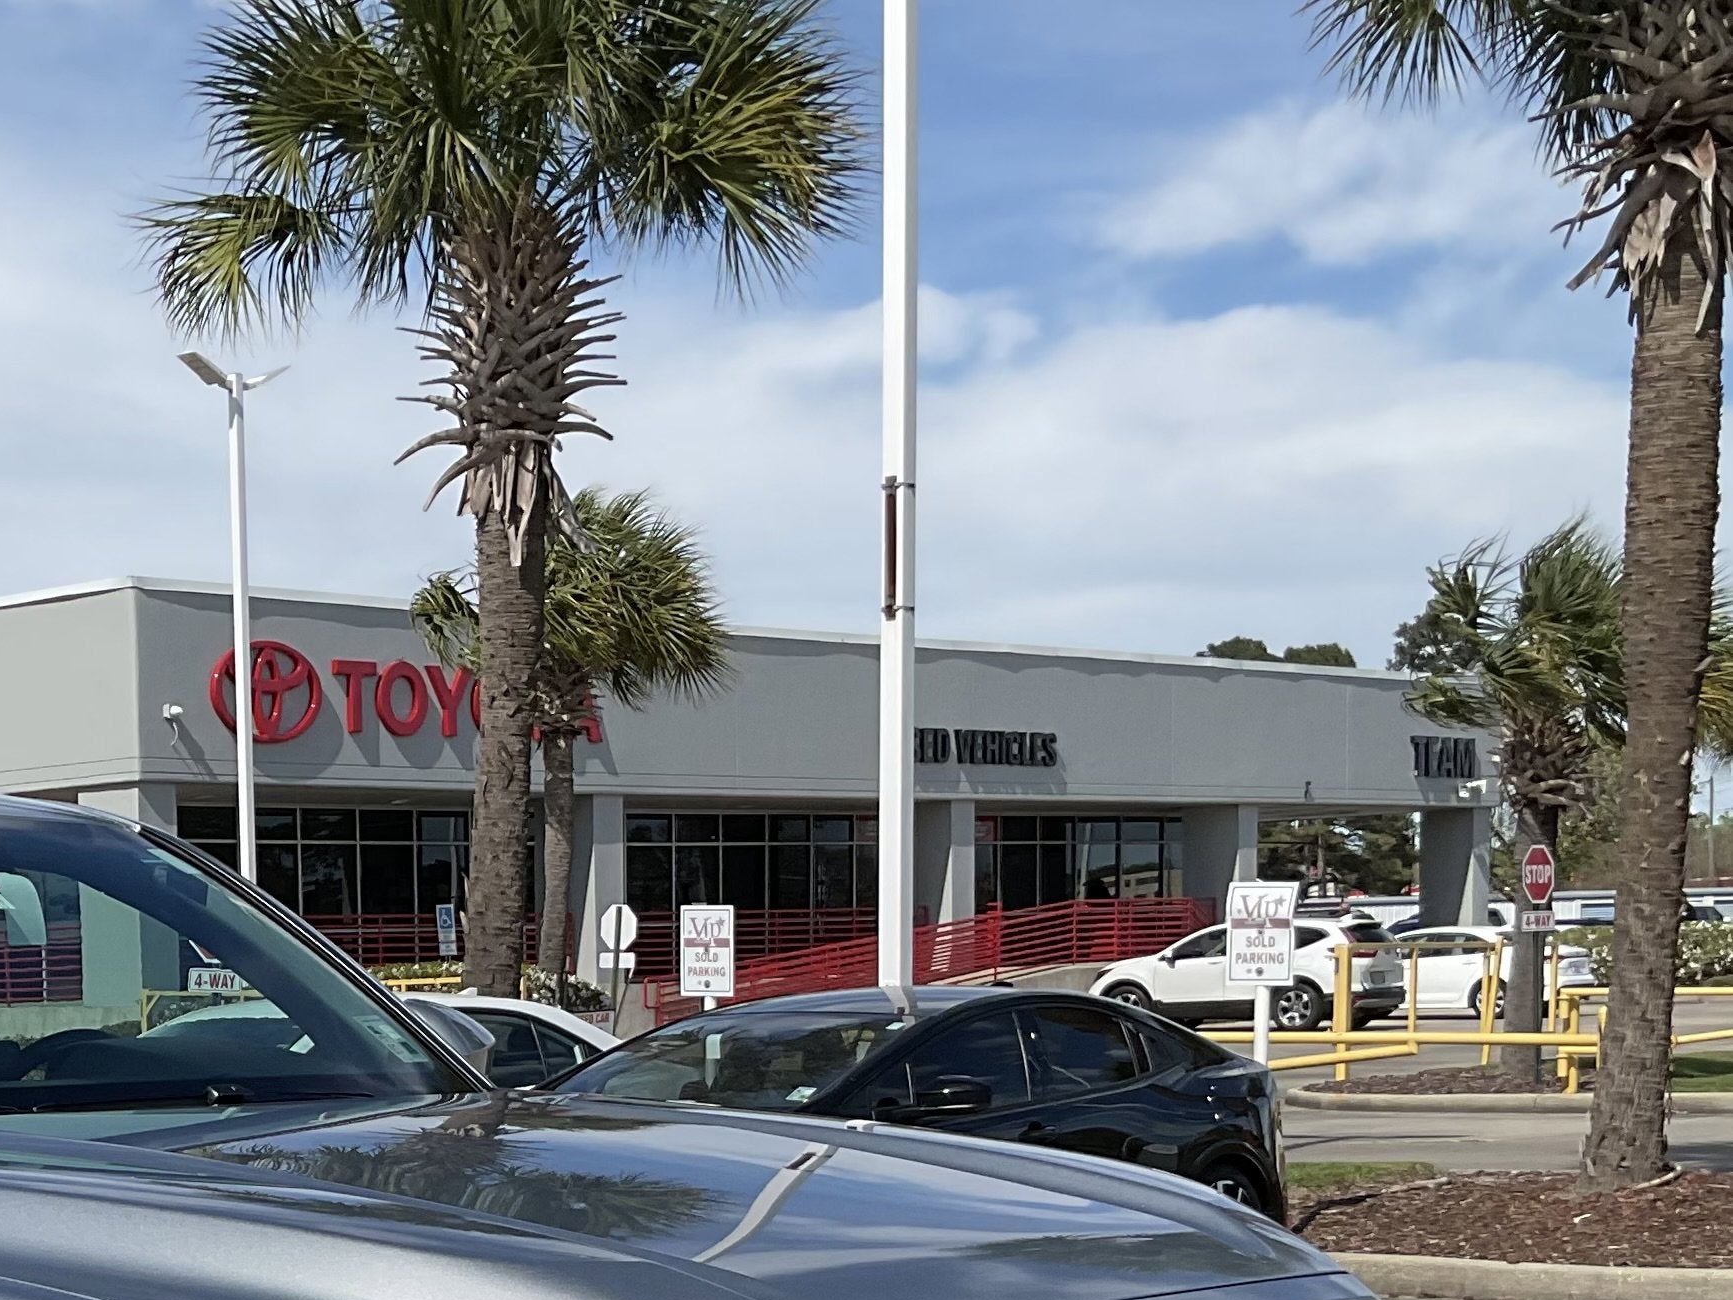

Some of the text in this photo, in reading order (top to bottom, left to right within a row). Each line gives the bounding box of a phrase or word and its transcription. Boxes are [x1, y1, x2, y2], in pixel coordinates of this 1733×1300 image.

[332, 659, 603, 743] TOY
[953, 729, 1057, 767] VEHICLES
[1409, 735, 1476, 778] TEAM
[1525, 864, 1551, 884] STOP
[1525, 915, 1551, 927] 4-WAY
[1245, 936, 1275, 948] SOLD
[695, 952, 719, 963] SOLD
[1235, 952, 1285, 965] PARKING
[687, 966, 726, 977] PARKING
[194, 972, 236, 989] 4-WAY
